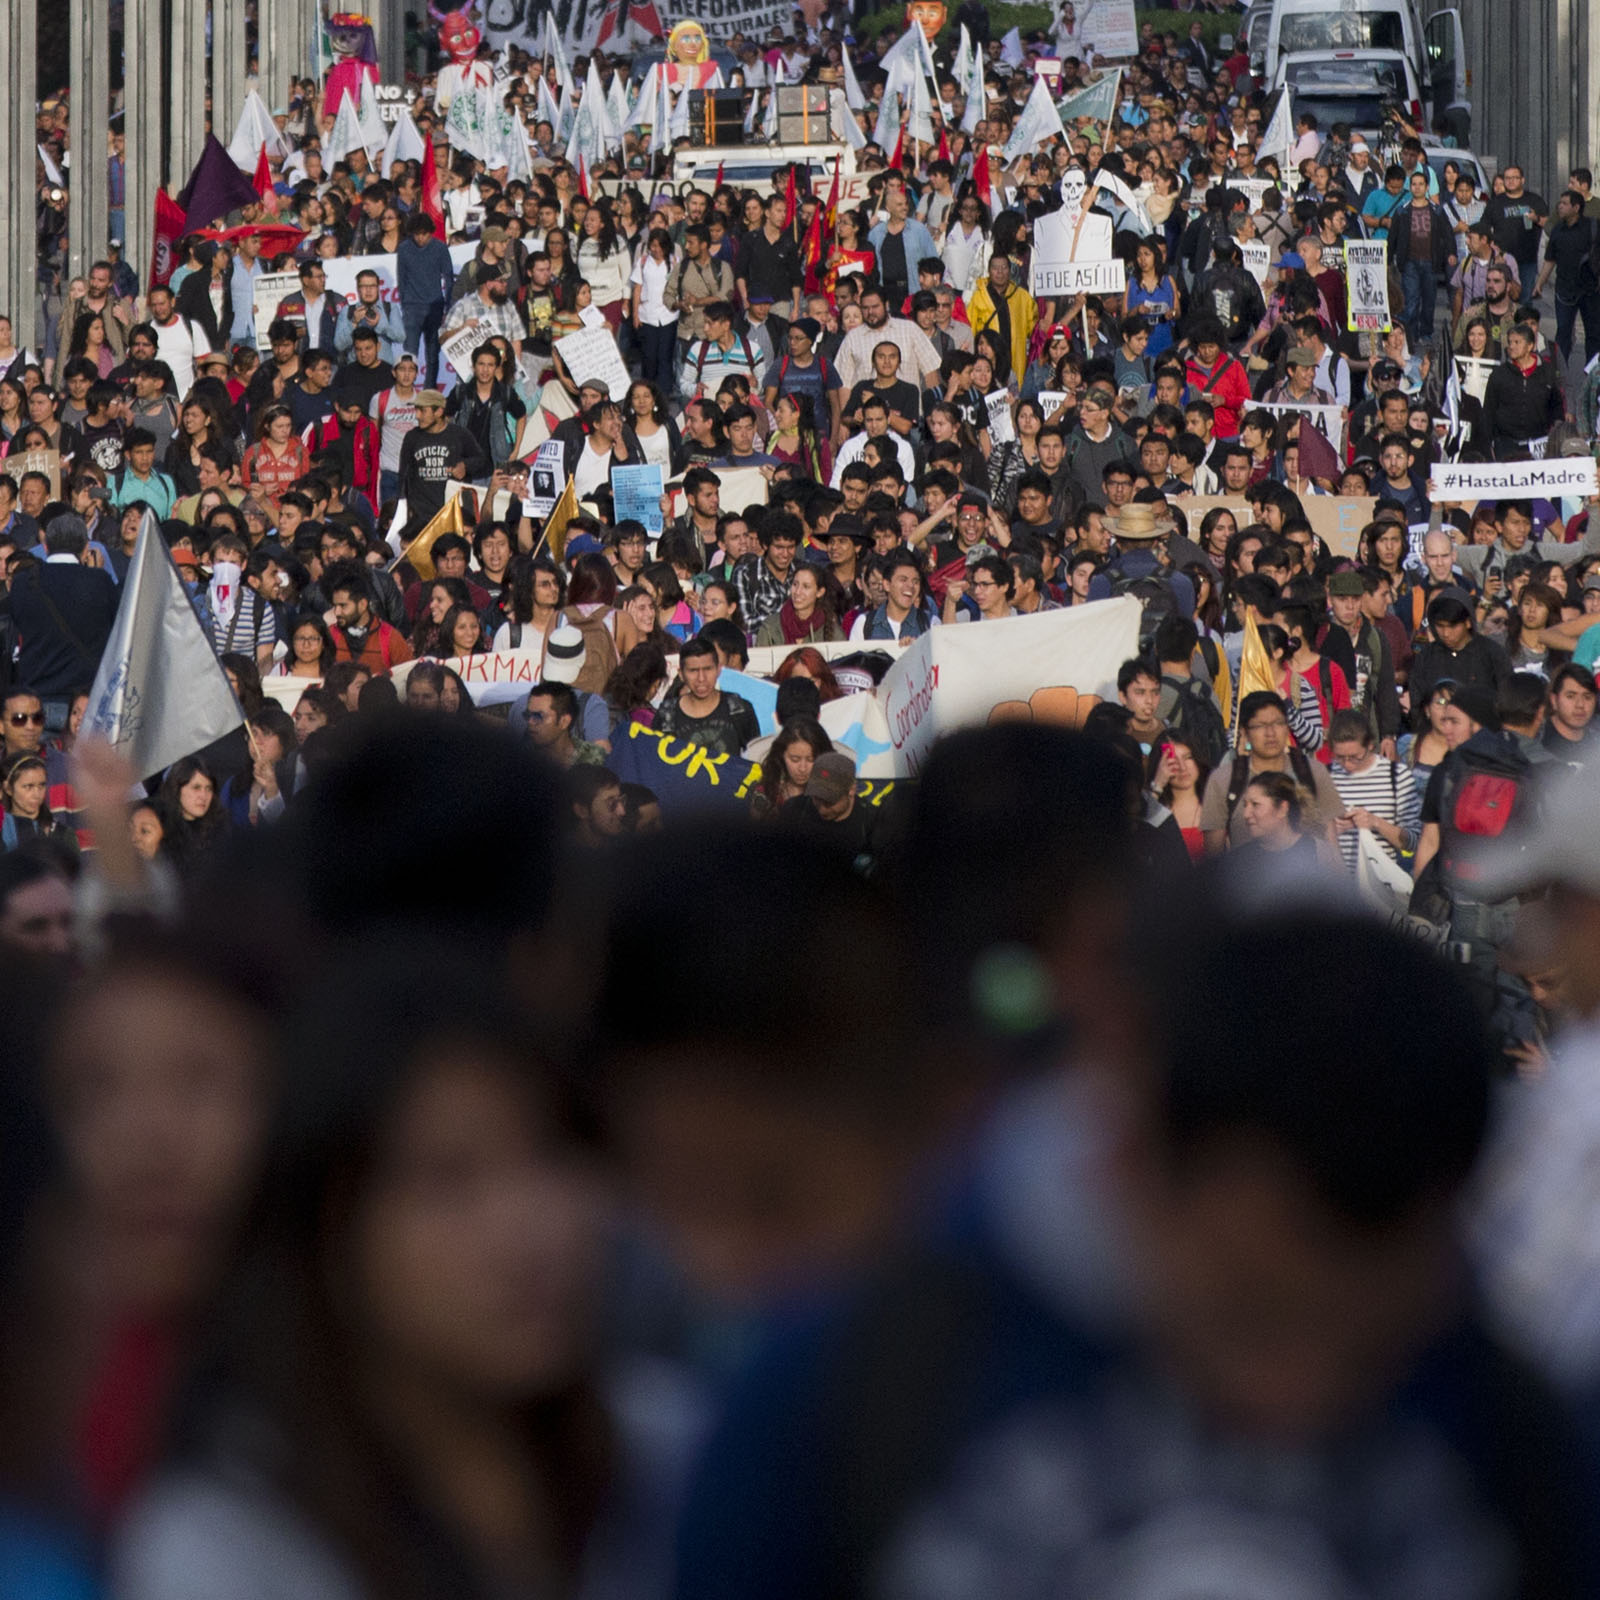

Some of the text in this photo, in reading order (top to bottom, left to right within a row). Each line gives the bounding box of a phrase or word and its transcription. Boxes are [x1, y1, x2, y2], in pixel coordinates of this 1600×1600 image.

[375, 84, 402, 100] NO
[1046, 271, 1071, 289] FUE
[1075, 264, 1100, 287] ASÍ
[1373, 289, 1384, 306] 43
[1443, 470, 1587, 492] #HastaLaMadre
